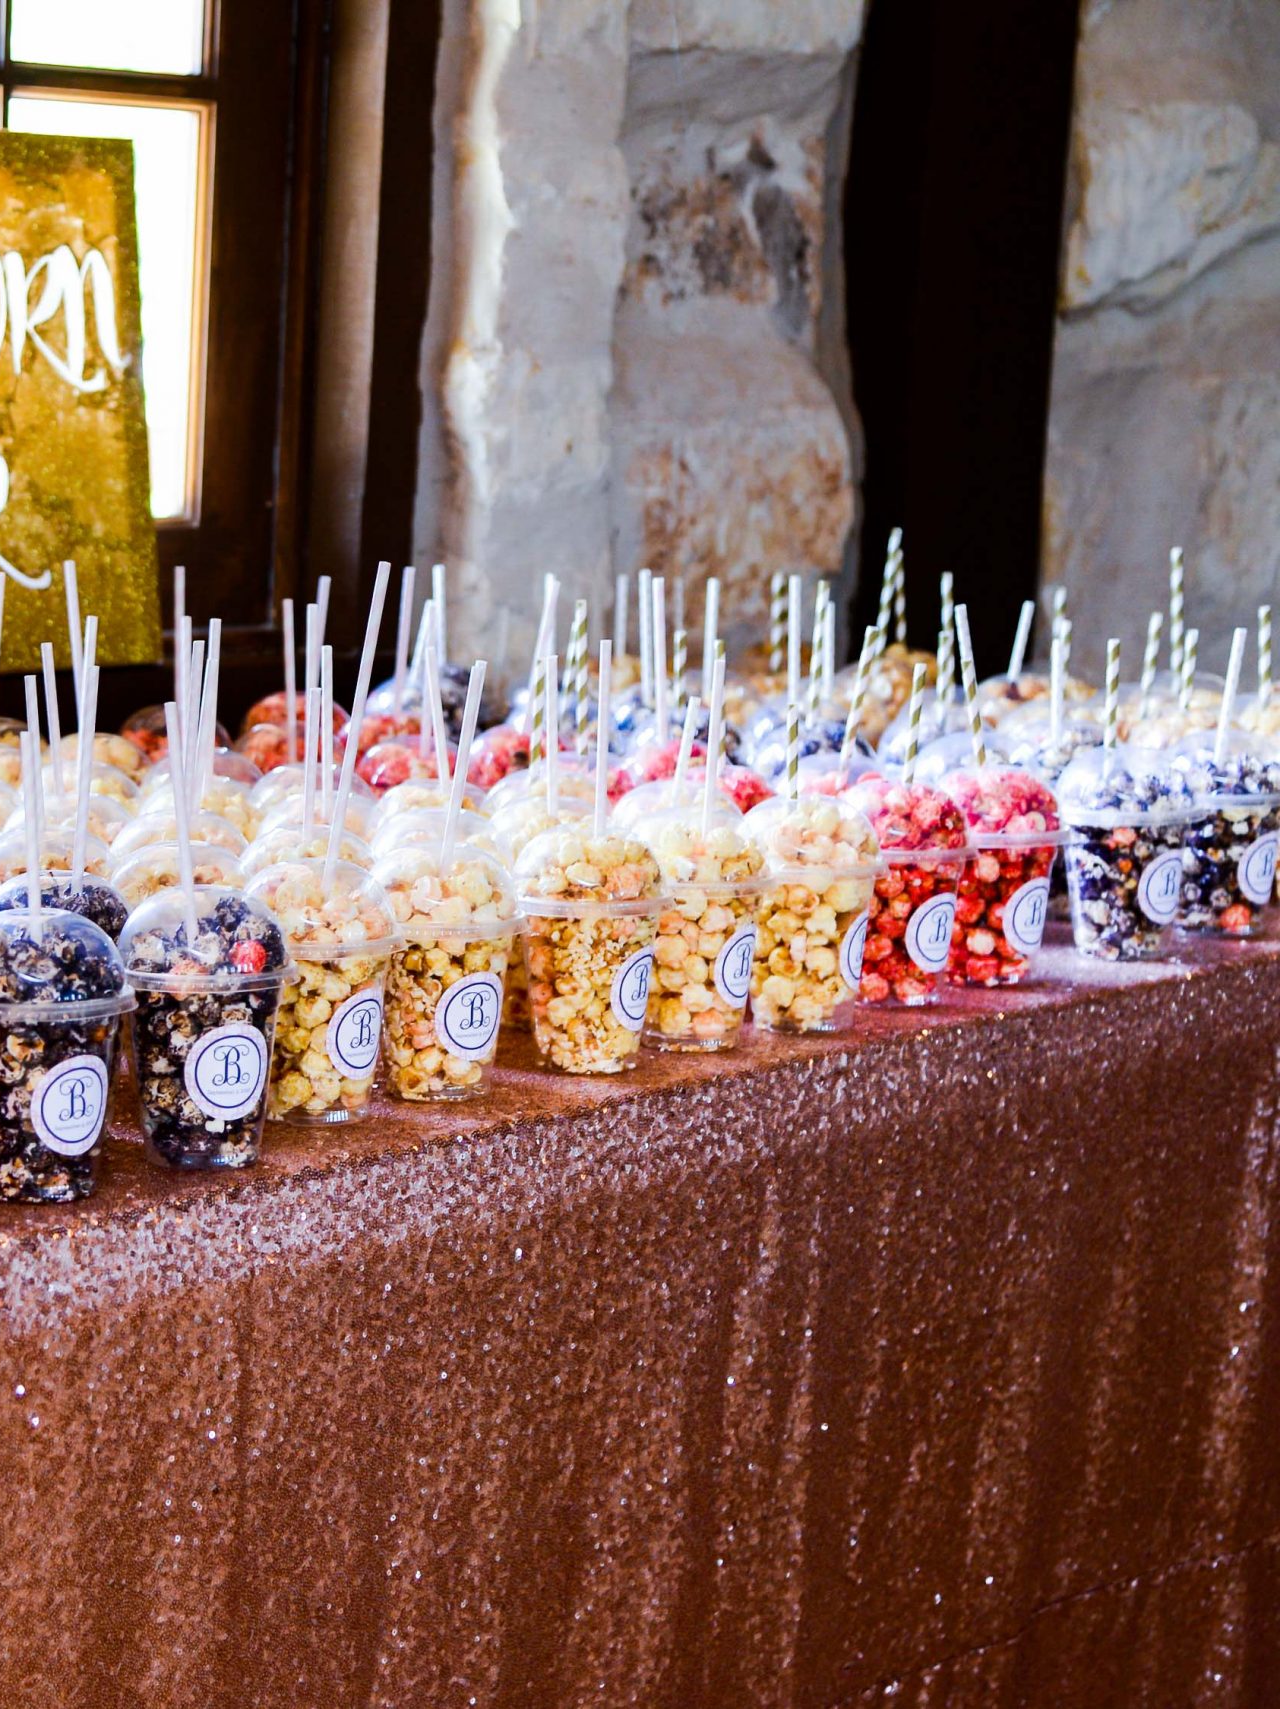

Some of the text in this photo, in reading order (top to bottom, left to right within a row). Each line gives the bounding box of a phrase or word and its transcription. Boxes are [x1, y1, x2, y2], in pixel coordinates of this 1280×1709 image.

[733, 941, 751, 980] B
[631, 963, 648, 1002] B
[350, 1007, 376, 1049] B
[460, 989, 490, 1031] B
[212, 1044, 250, 1087] B
[58, 1074, 95, 1122] B
